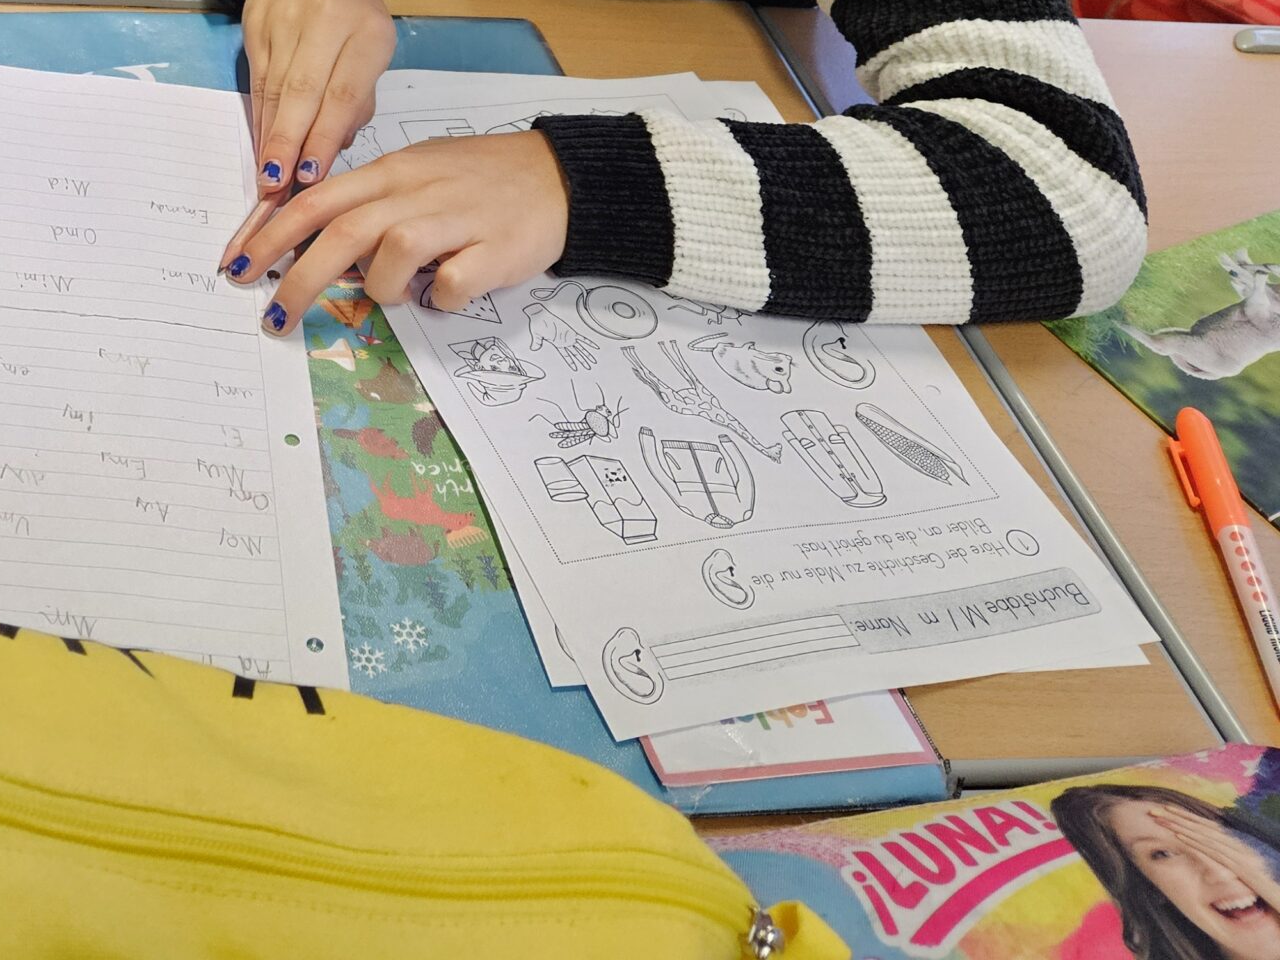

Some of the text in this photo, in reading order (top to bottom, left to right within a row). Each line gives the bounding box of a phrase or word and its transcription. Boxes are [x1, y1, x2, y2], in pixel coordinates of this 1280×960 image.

[15, 271, 74, 293] Mimi
[411, 458, 464, 478] rica
[436, 479, 474, 503] rth
[946, 517, 992, 538] Bilder
[827, 530, 871, 557] gehört
[875, 534, 897, 551] du
[894, 531, 919, 548] die
[969, 539, 1012, 558] Höre
[867, 552, 947, 577] Geschichte
[944, 547, 969, 565] der
[752, 573, 776, 591] die
[778, 570, 803, 584] nur
[804, 565, 846, 584] Male
[985, 582, 1091, 620] Buchstabe
[848, 615, 912, 638] Name:
[917, 611, 941, 627] m
[958, 604, 991, 629] M
[851, 800, 1058, 936] ¡LUNA!
